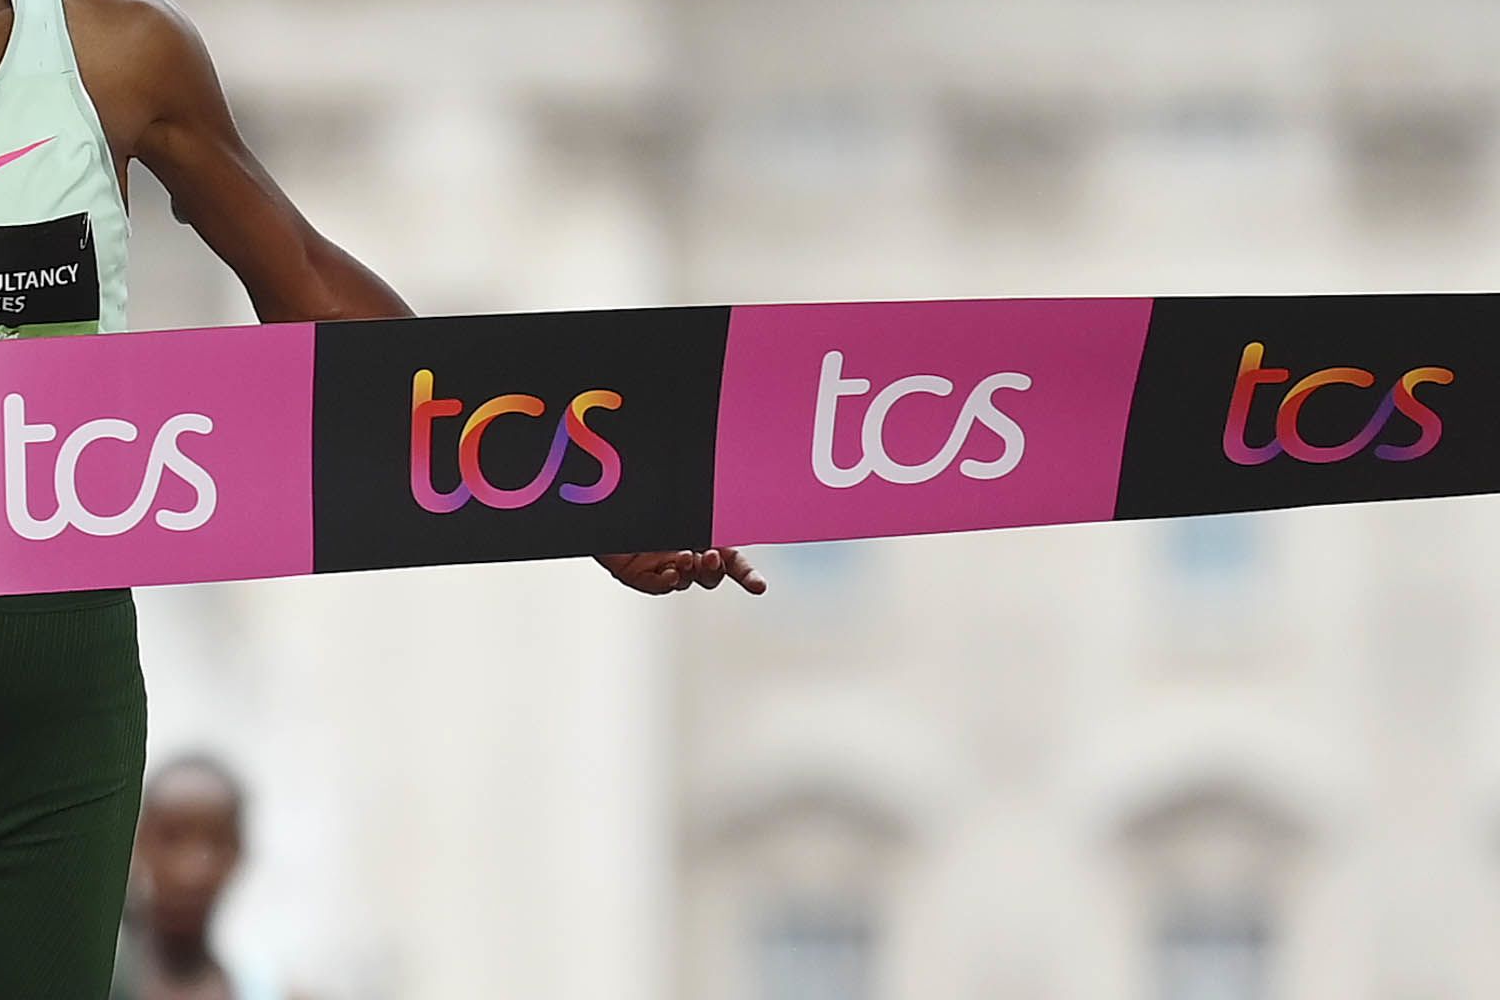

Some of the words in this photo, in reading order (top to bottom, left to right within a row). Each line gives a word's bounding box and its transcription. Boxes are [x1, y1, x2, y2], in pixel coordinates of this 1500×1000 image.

[3, 393, 218, 541] tcs
[410, 368, 624, 515] tcs
[811, 350, 1033, 489] tcs
[1222, 341, 1455, 467] tcs
